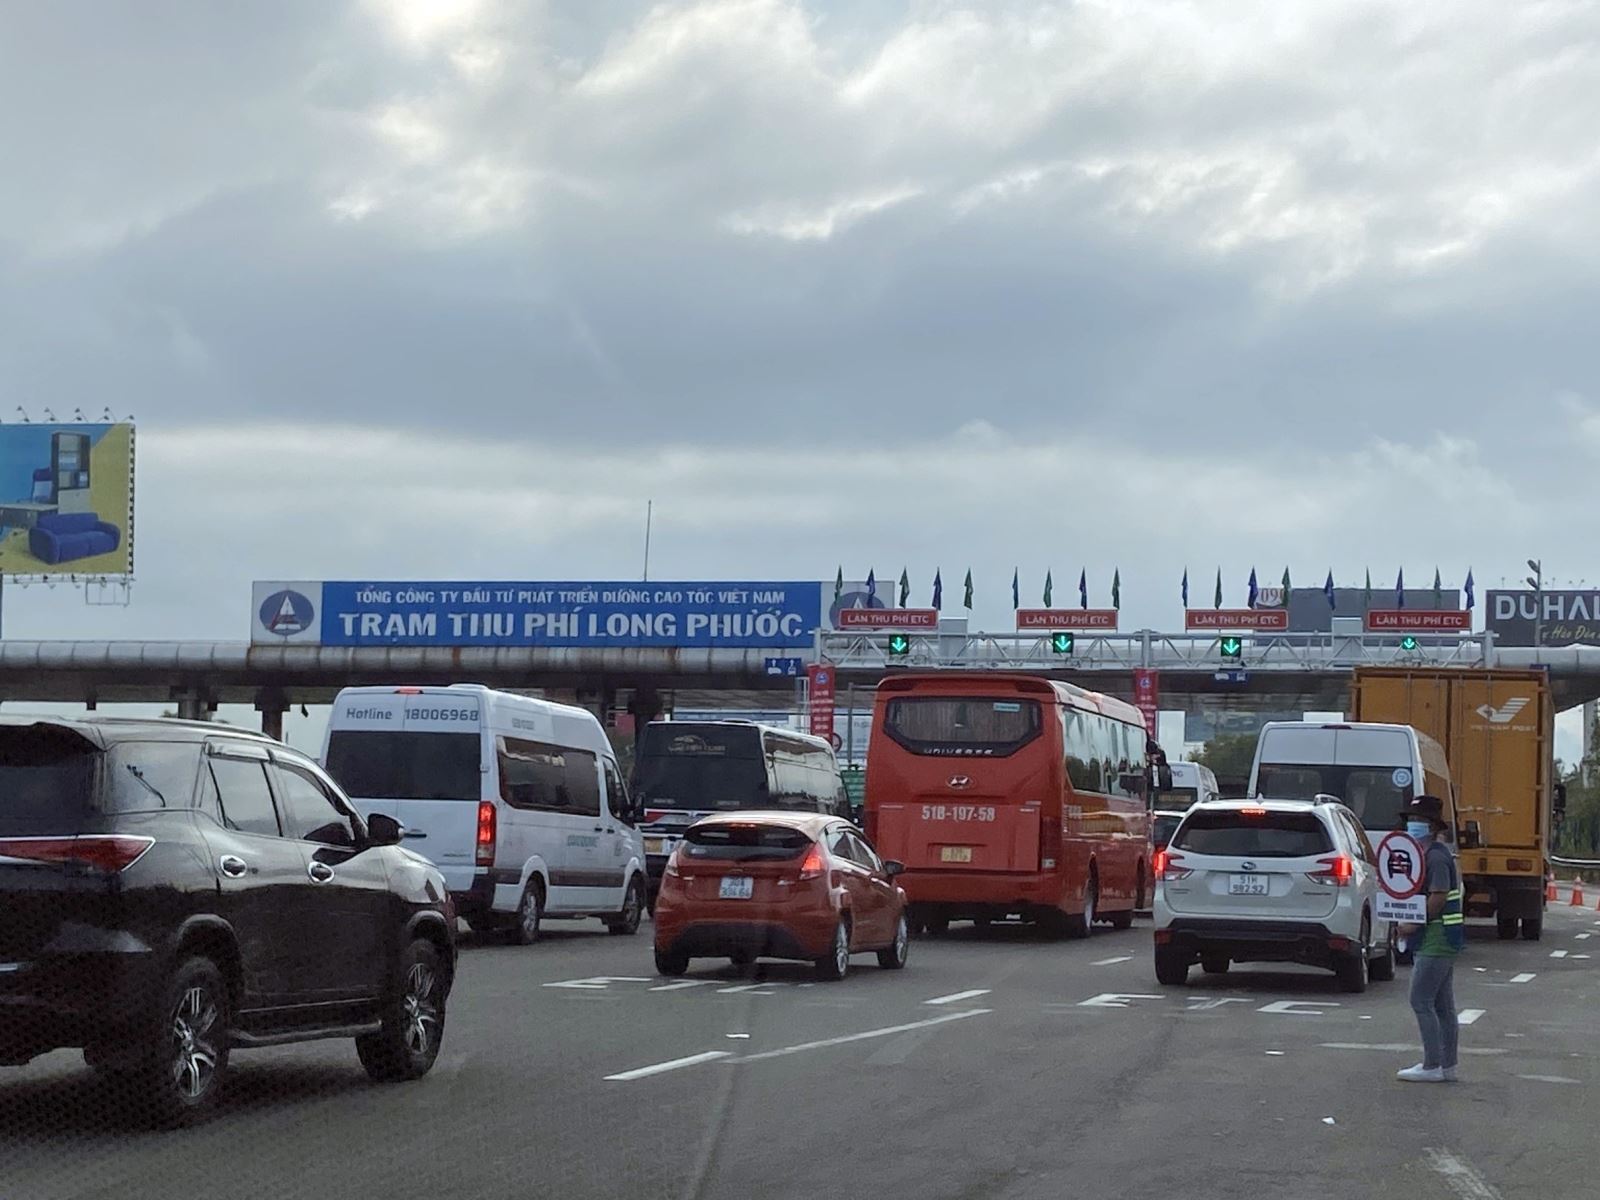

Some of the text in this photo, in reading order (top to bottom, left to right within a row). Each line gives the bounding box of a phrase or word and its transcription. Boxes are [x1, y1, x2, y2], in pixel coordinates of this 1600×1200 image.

[396, 587, 435, 603] CÔNG
[440, 591, 459, 603] TY
[495, 588, 515, 603] TƯ
[654, 591, 682, 603] CAO
[753, 591, 785, 603] NAM
[339, 606, 803, 642] TRẠM THU PHÍ LONG PHƯỚC
[869, 615, 890, 624] THU
[892, 614, 909, 624] PHÍ
[910, 615, 929, 624] ETC
[1049, 615, 1069, 624] THU
[1071, 614, 1088, 624] PHÍ
[1090, 615, 1109, 624] ETC
[1218, 615, 1239, 624] THU
[1241, 614, 1258, 624] PHÍ
[1260, 615, 1279, 624] ETC
[1400, 615, 1421, 625] THU
[1423, 614, 1441, 625] PHÍ
[1443, 615, 1463, 625] ETC
[346, 707, 480, 721] Hotline 18006968
